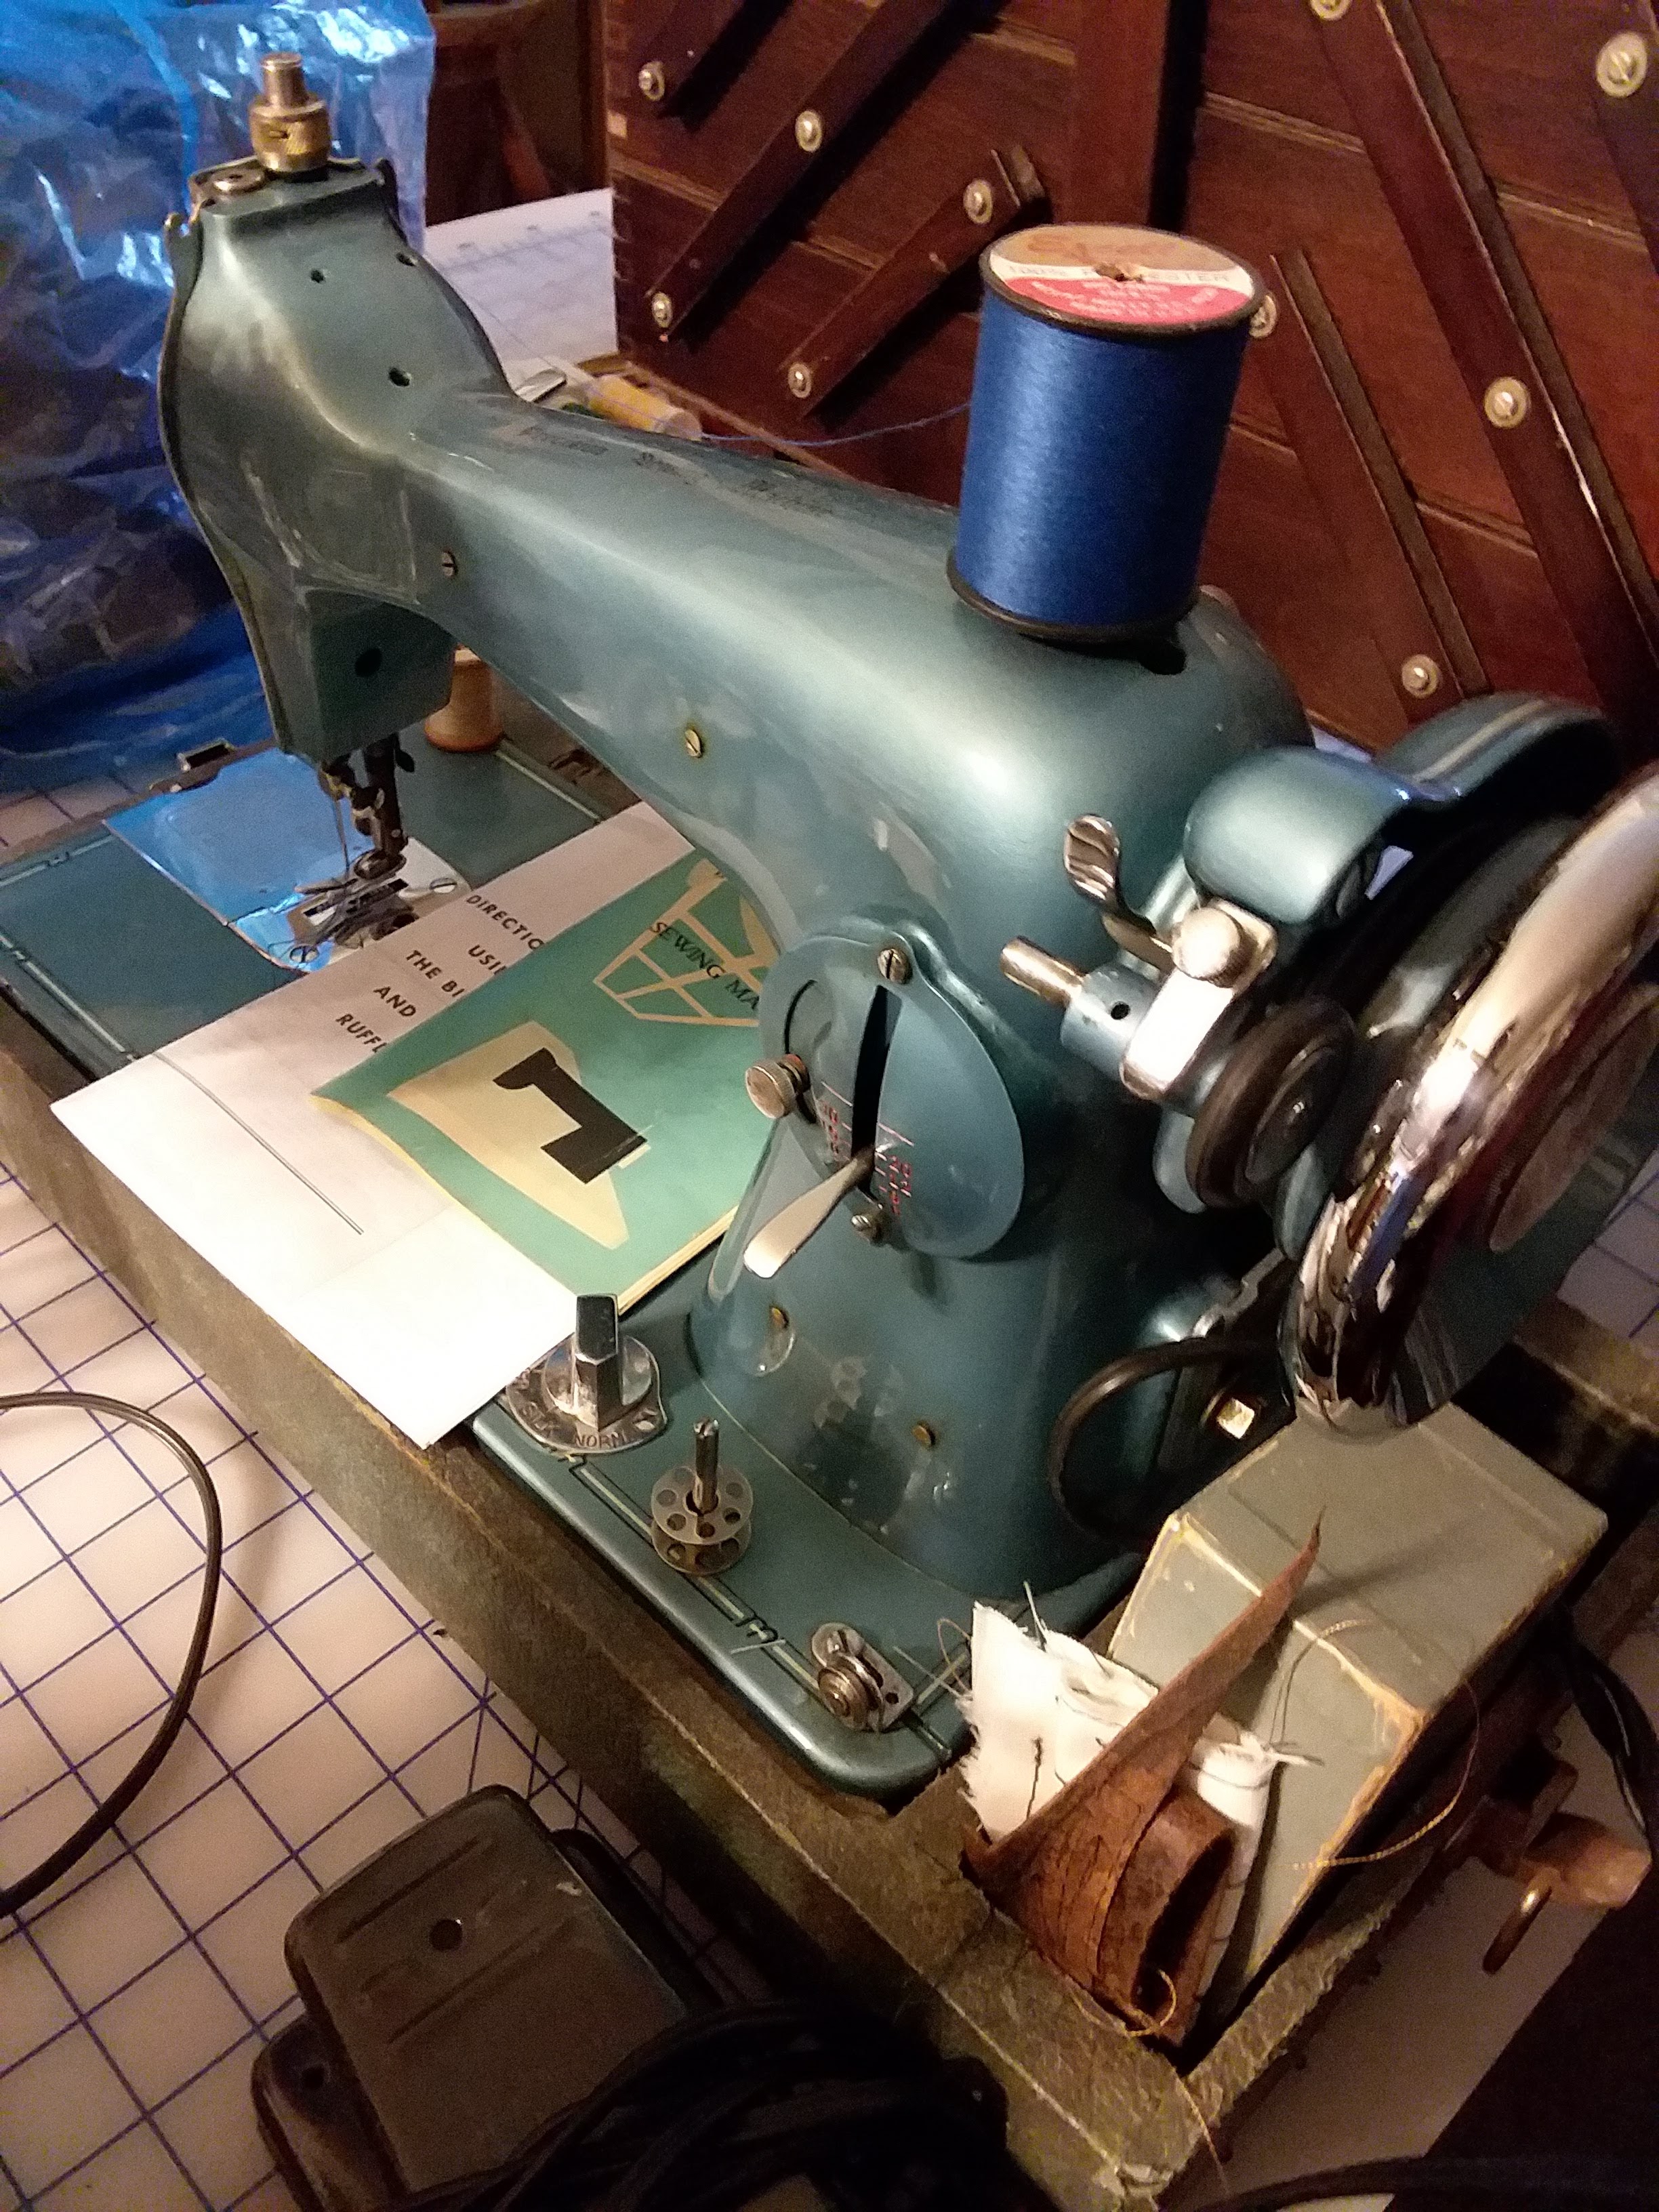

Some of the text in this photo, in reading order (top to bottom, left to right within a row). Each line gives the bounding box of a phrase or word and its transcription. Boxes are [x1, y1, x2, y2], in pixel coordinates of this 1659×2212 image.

[406, 949, 465, 998] THE BI
[650, 922, 726, 979] SEWING
[373, 986, 417, 1017] AND
